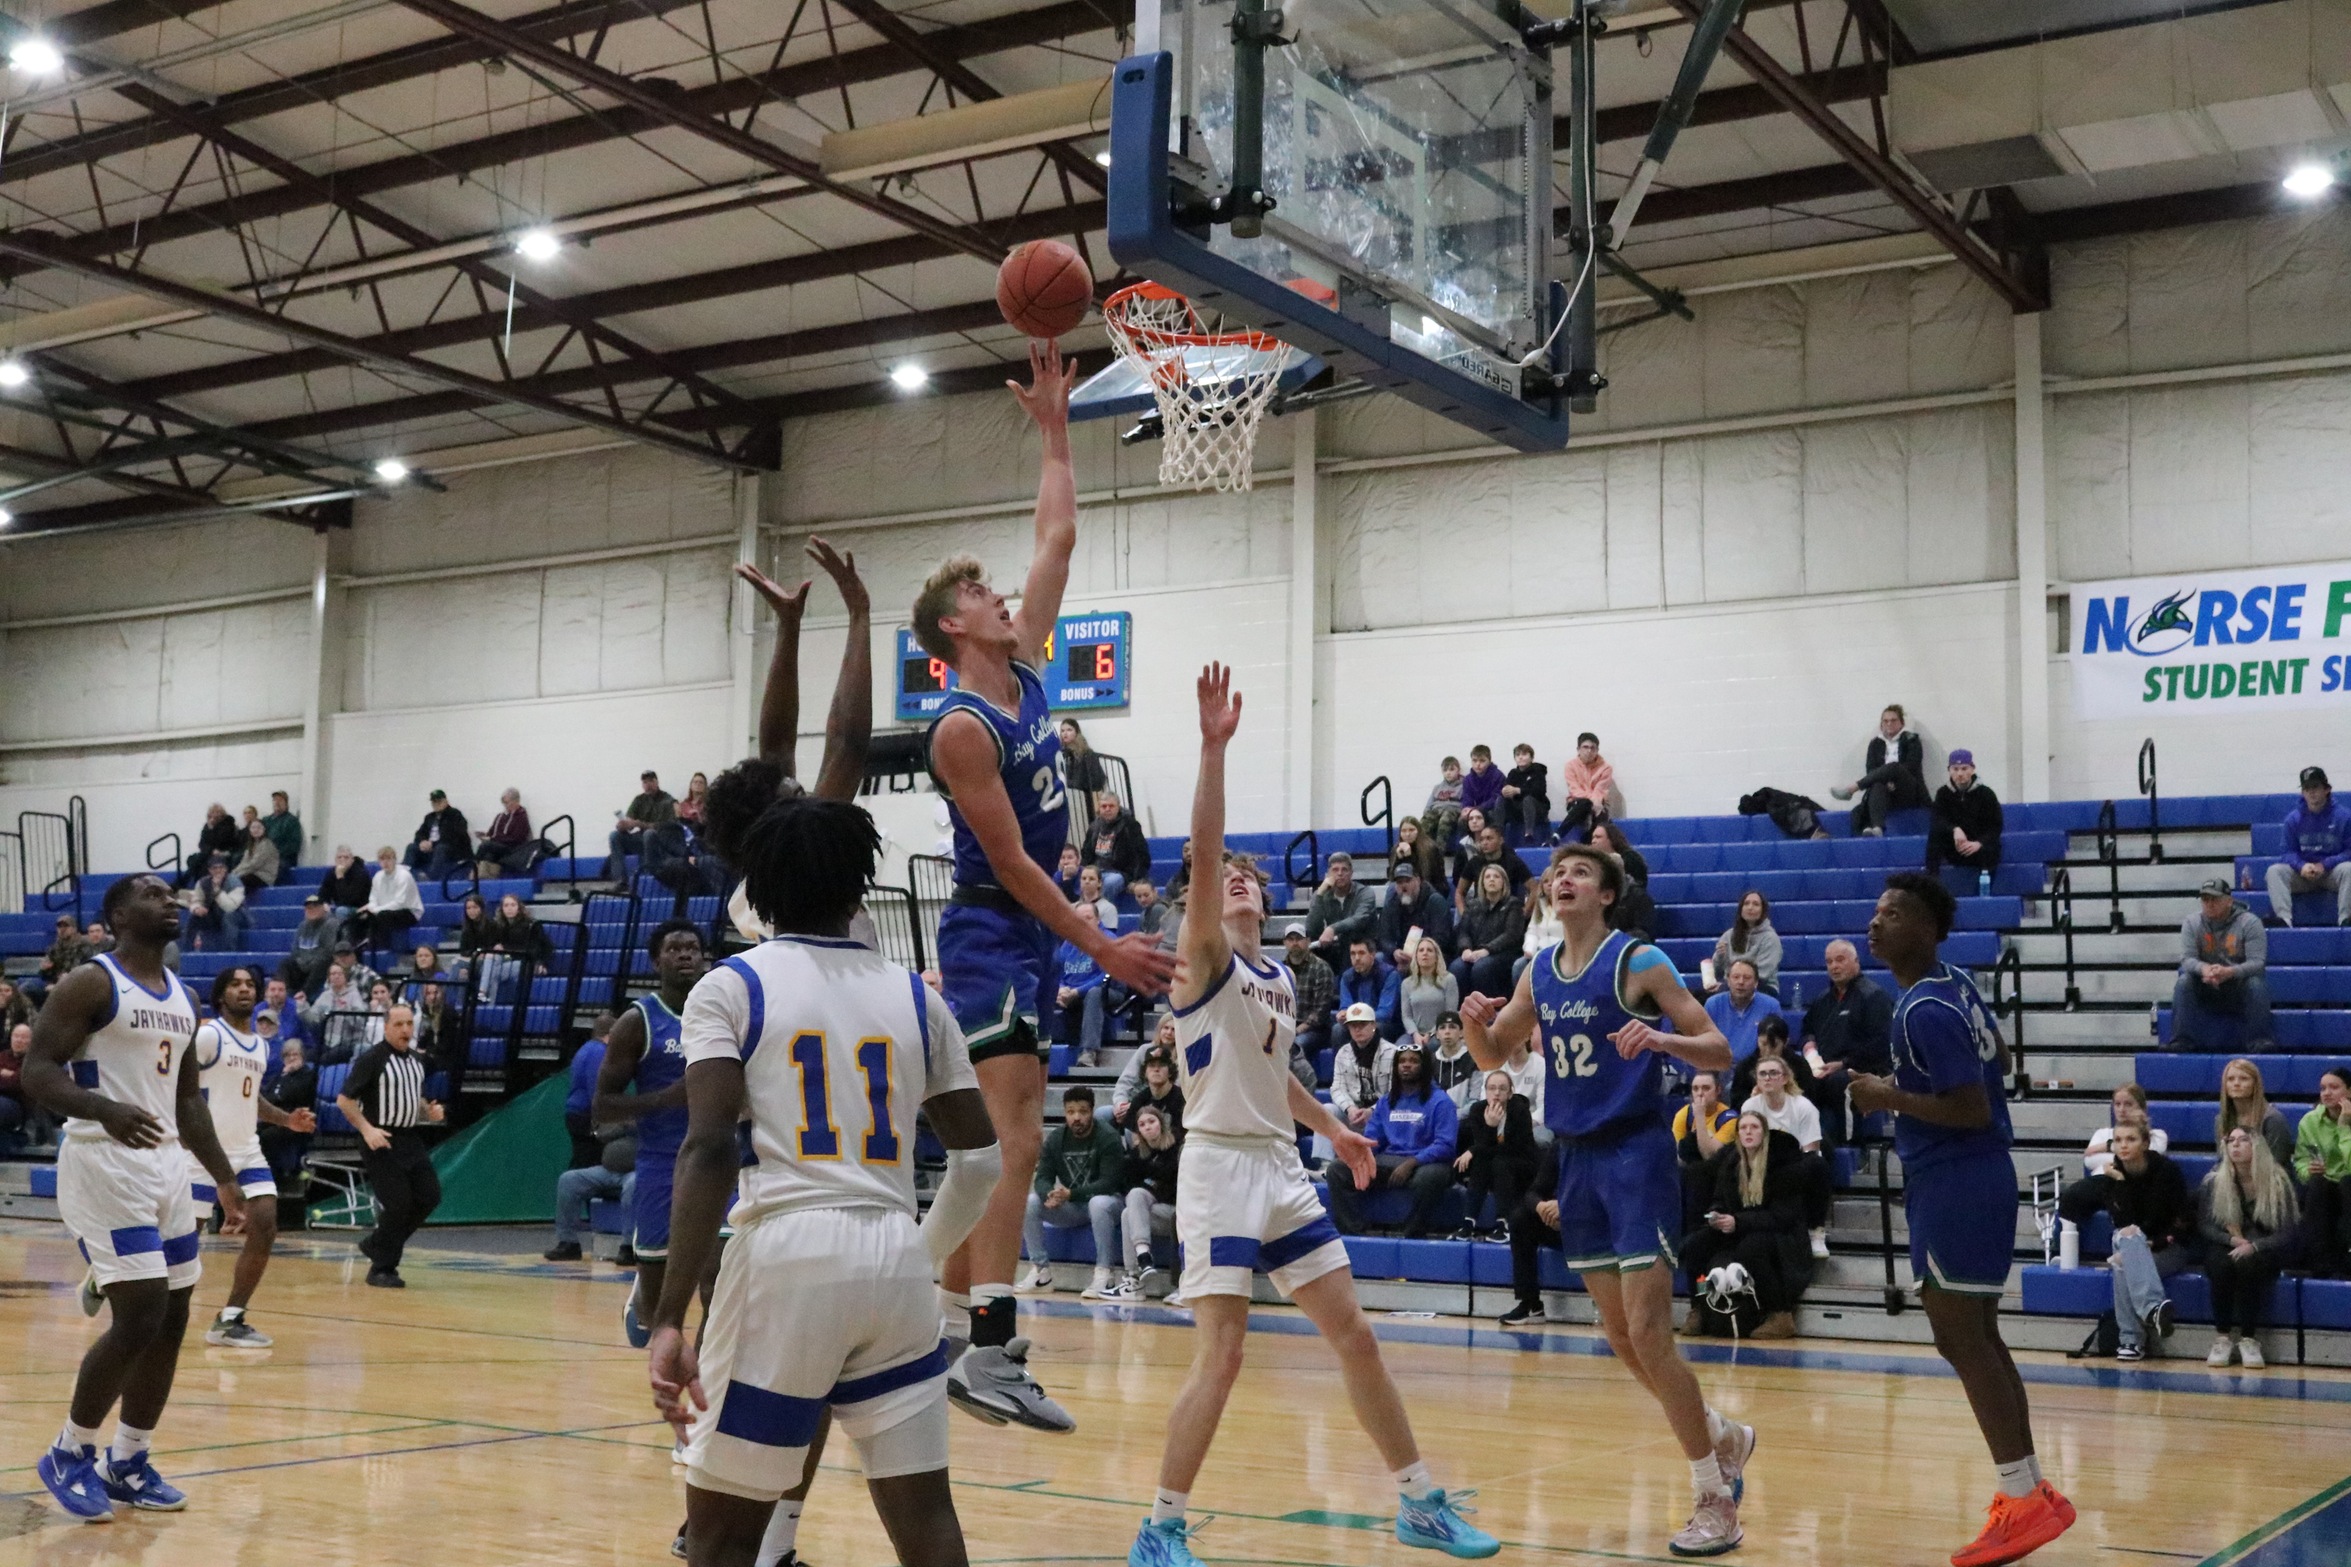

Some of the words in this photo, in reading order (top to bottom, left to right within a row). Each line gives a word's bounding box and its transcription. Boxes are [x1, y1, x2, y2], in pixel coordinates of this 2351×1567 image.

[1065, 619, 1120, 640] VISITOR
[929, 657, 947, 690] 9
[1095, 643, 1115, 679] 6
[1060, 686, 1095, 702] BONUS
[2142, 658, 2310, 703] STUDENT
[921, 695, 948, 711] BON
[130, 1008, 192, 1036] JAYHAWKS
[1540, 1002, 1557, 1027] Bay
[1559, 999, 1599, 1025] College
[1262, 1016, 1277, 1056] 1
[156, 1039, 172, 1076] 3
[1551, 1033, 1599, 1079] 32
[242, 1075, 253, 1098] 0
[788, 1029, 902, 1167] 11
